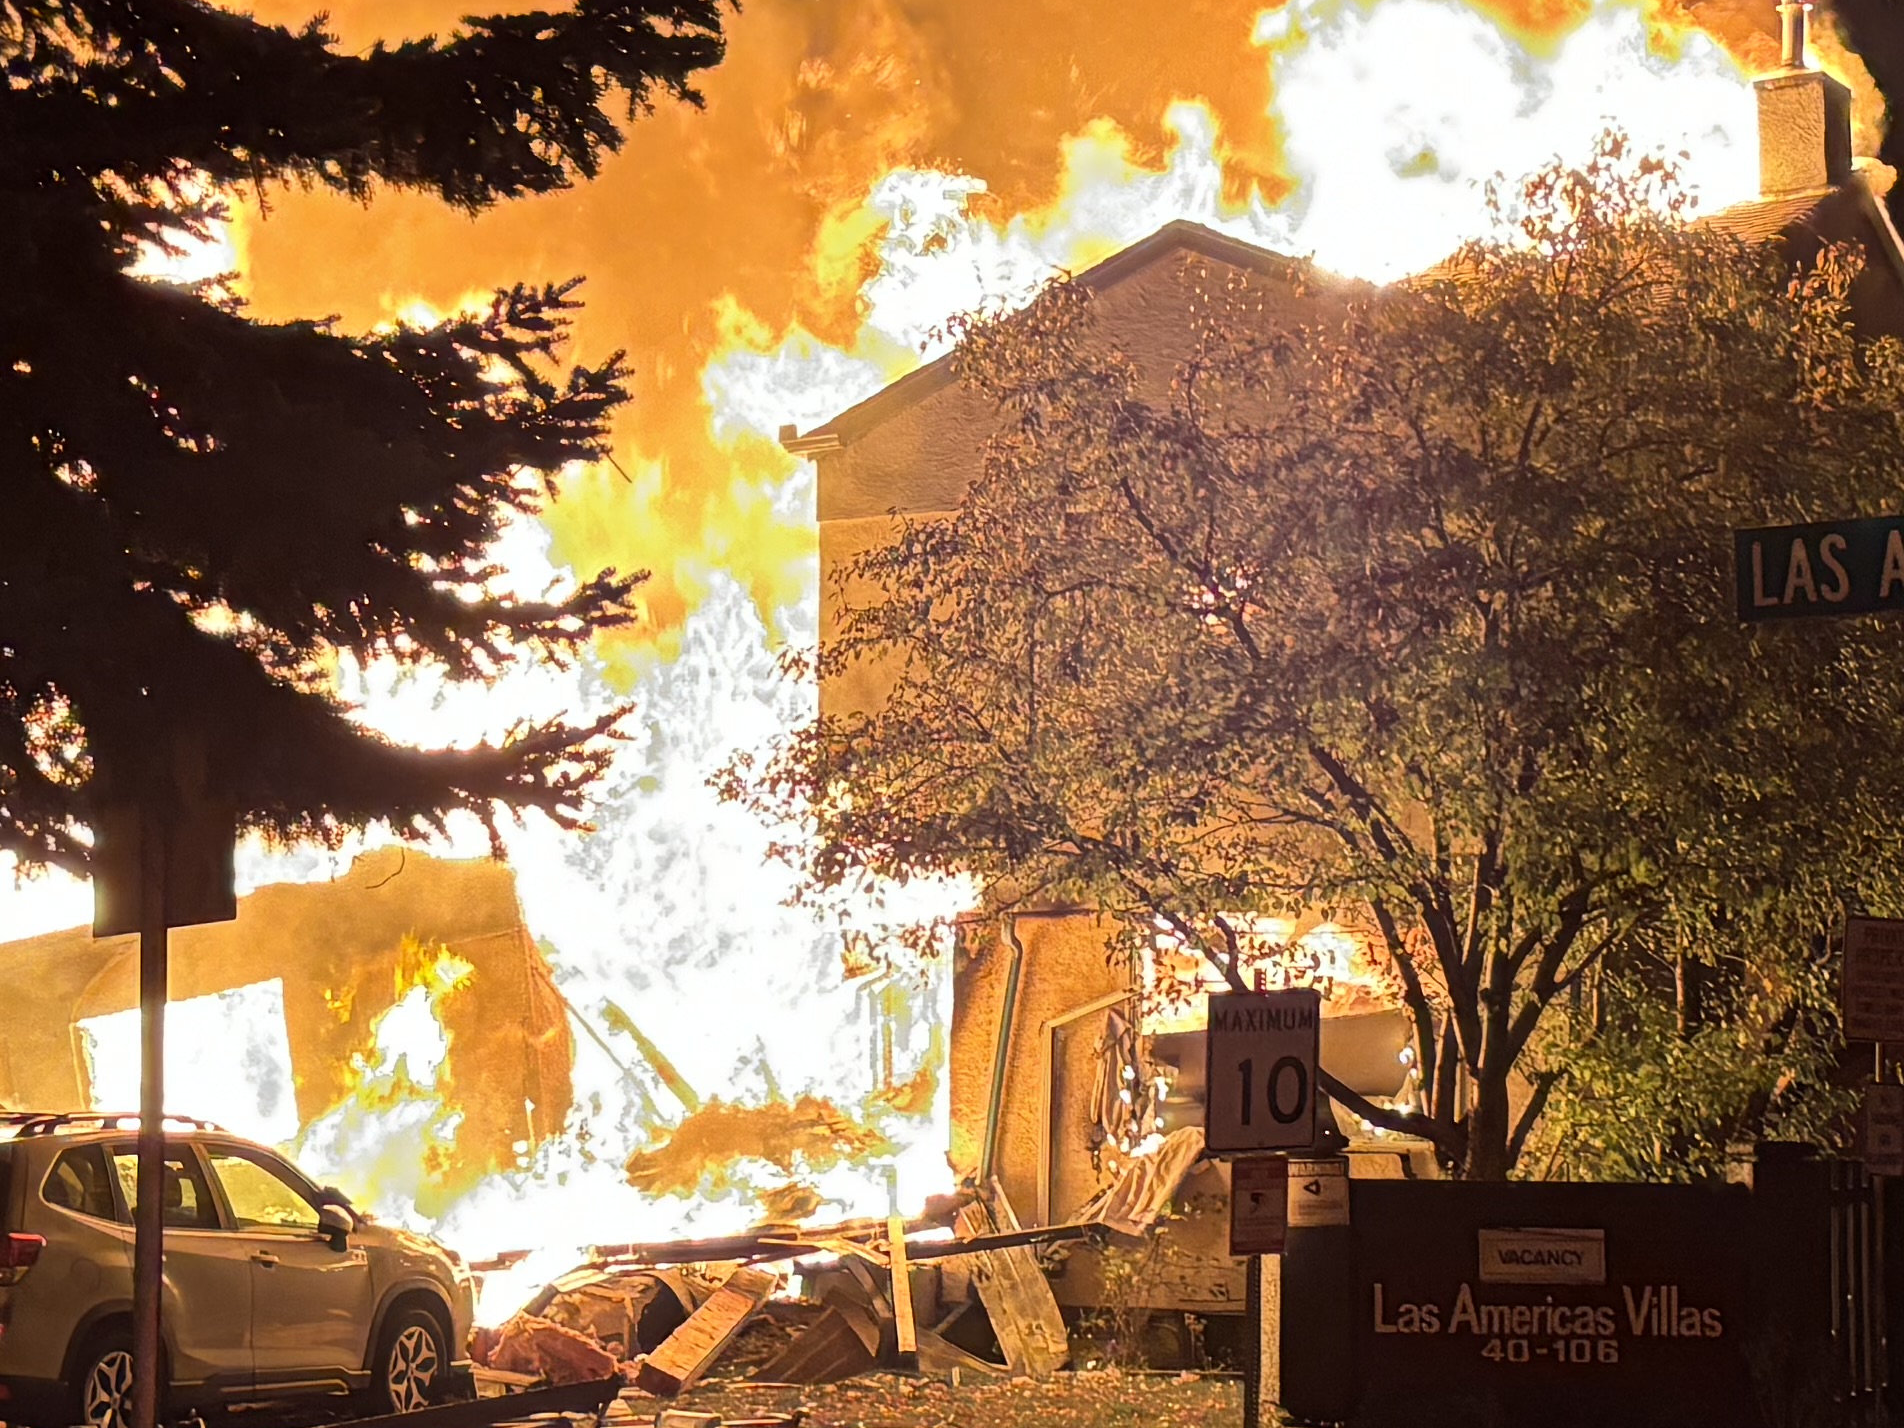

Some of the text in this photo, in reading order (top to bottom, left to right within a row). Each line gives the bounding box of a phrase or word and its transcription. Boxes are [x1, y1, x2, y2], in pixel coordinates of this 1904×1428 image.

[1751, 533, 1850, 607] LAS
[1215, 1007, 1313, 1032] MAXIMUM
[1238, 1056, 1307, 1126] 10
[1498, 1248, 1584, 1267] VACANCY
[1372, 1281, 1726, 1339] Las Americas Villas
[1480, 1337, 1620, 1364] 40-106
